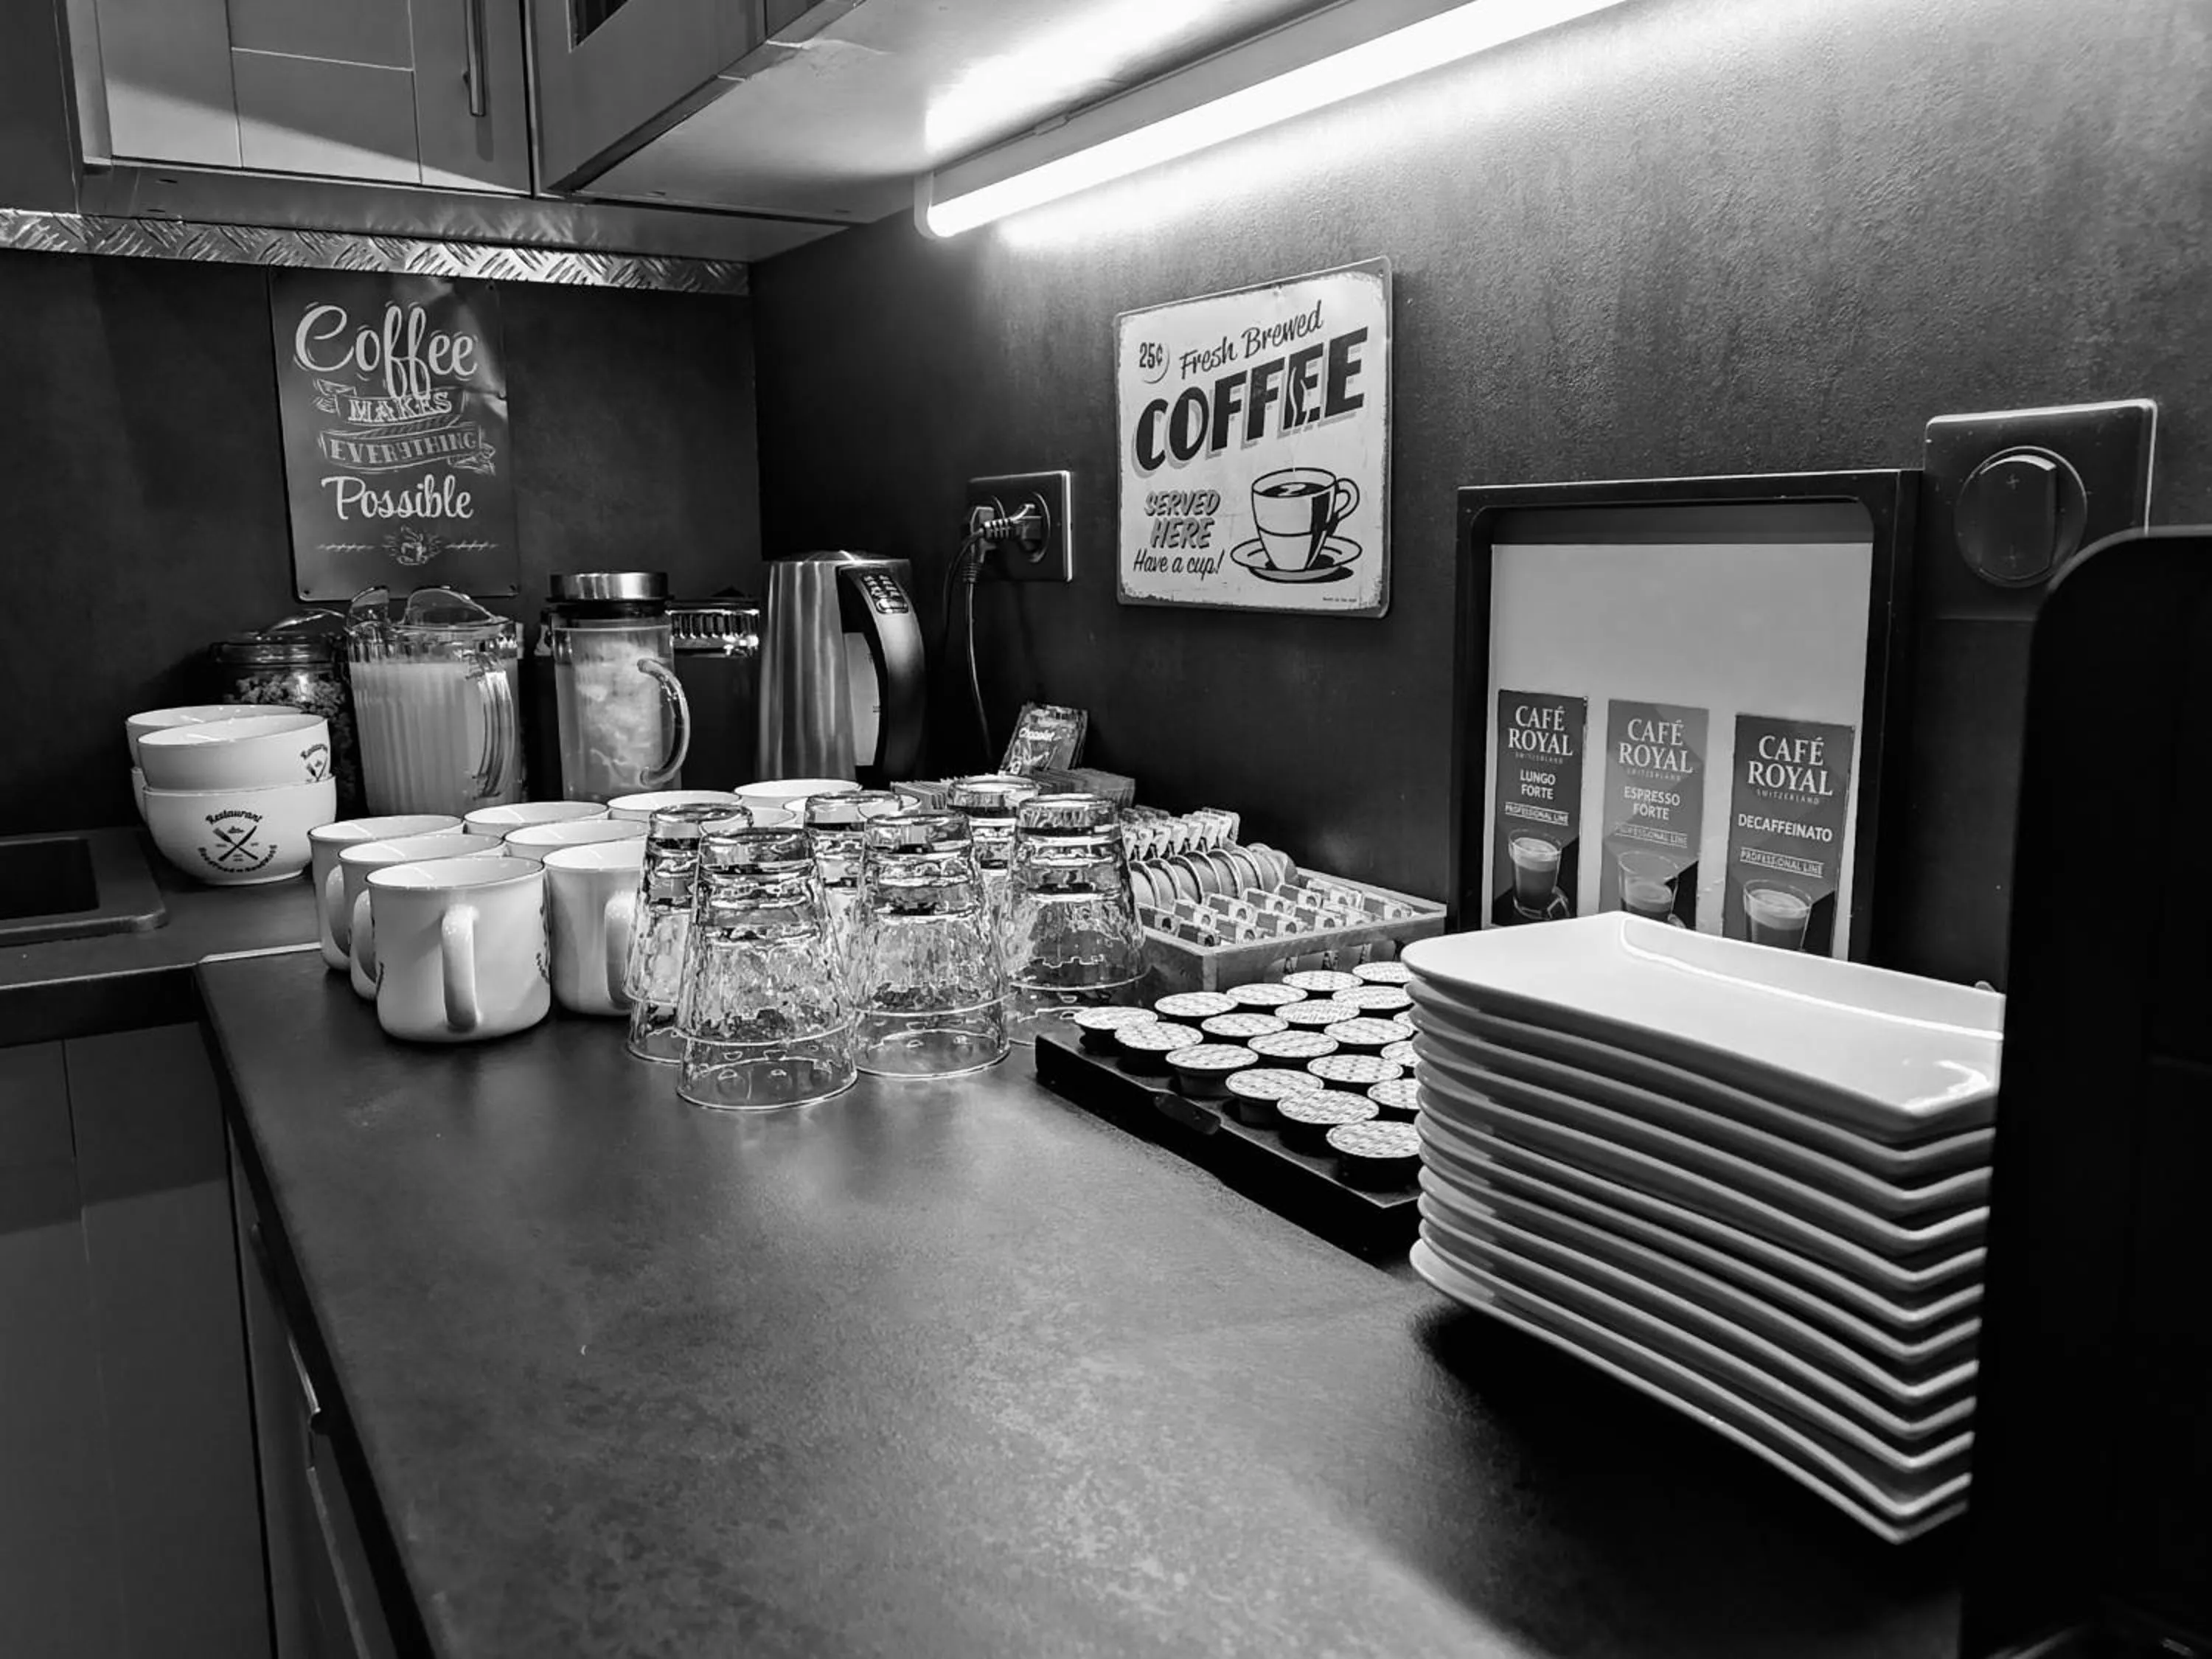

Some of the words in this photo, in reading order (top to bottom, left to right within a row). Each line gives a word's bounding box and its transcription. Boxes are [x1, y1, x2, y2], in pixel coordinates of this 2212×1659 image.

[296, 304, 479, 400] Coffee
[1180, 336, 1238, 380] Fresh
[1242, 299, 1324, 359] Brewed
[1138, 342, 1163, 369] 25¢
[348, 392, 452, 422] MAKES
[1133, 326, 1368, 475] COFFEE
[330, 431, 476, 464] EVERYTHING
[321, 474, 474, 520] Possible
[1144, 490, 1221, 516] SERVED
[1150, 518, 1215, 549] HERE
[1133, 548, 1169, 573] Have
[1172, 557, 1184, 573] a
[1186, 549, 1225, 581] cup!
[1515, 705, 1565, 731] CAFÉ
[1627, 718, 1684, 746] CAFÉ
[1508, 728, 1573, 756] ROYAL
[1759, 735, 1824, 766] CAFÉ
[1618, 742, 1694, 773] ROYAL
[1520, 768, 1556, 785] LUNGO
[1747, 760, 1833, 796] ROYAL
[1521, 784, 1554, 800] FORTE
[1624, 786, 1680, 806] ESPRESSO
[1633, 803, 1670, 821] FORTE
[1738, 813, 1832, 842] DECAFFEINATO
